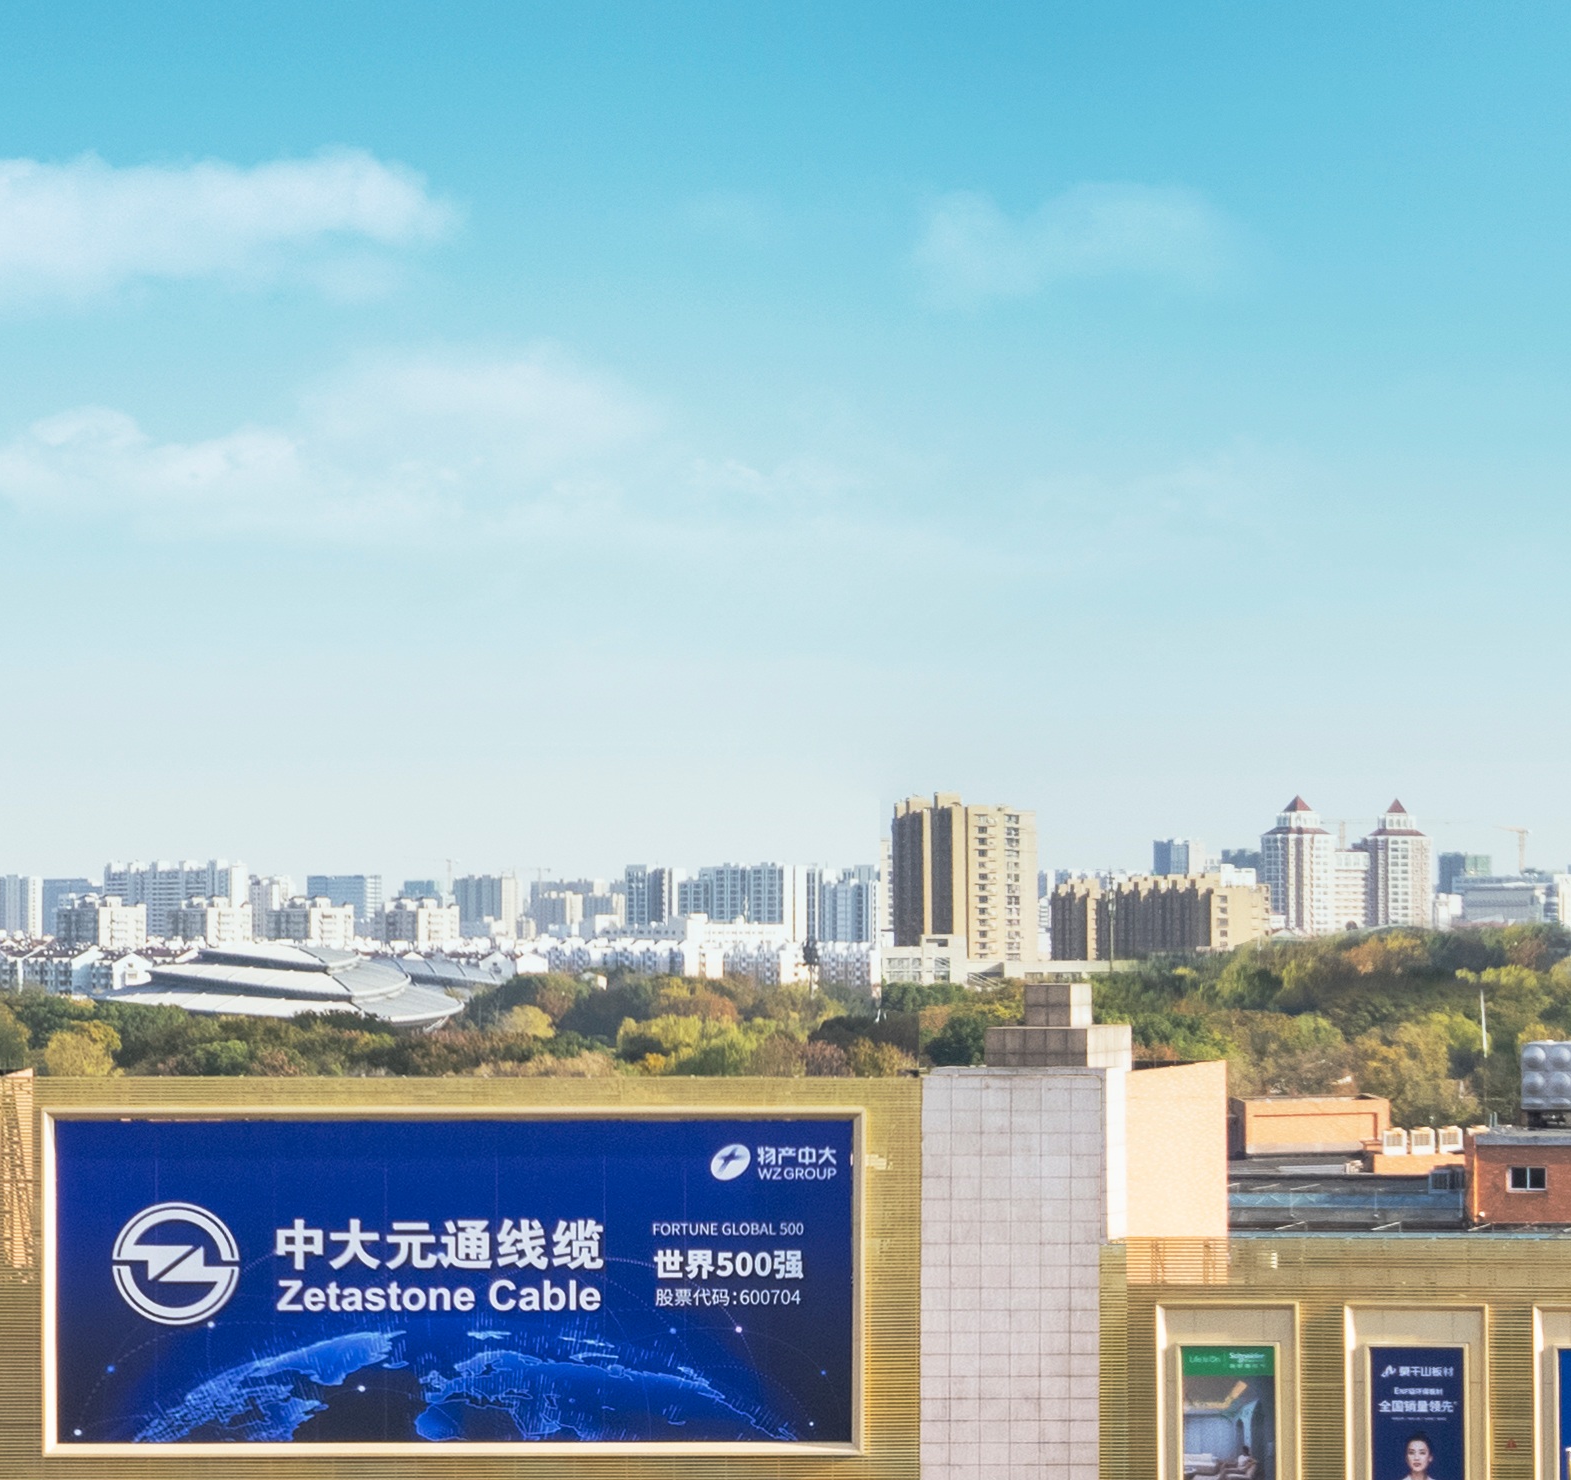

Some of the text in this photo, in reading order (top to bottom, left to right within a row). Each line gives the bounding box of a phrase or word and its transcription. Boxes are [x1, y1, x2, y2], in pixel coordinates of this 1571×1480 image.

[757, 1146, 837, 1166] 物产中大
[757, 1167, 837, 1180] WZ GROUP
[653, 1223, 804, 1235] FORTUNE GLOBAL 500
[275, 1218, 604, 1271] 中大元通线缆
[653, 1249, 804, 1281] 世界500强
[276, 1280, 601, 1312] Zetastone Cable
